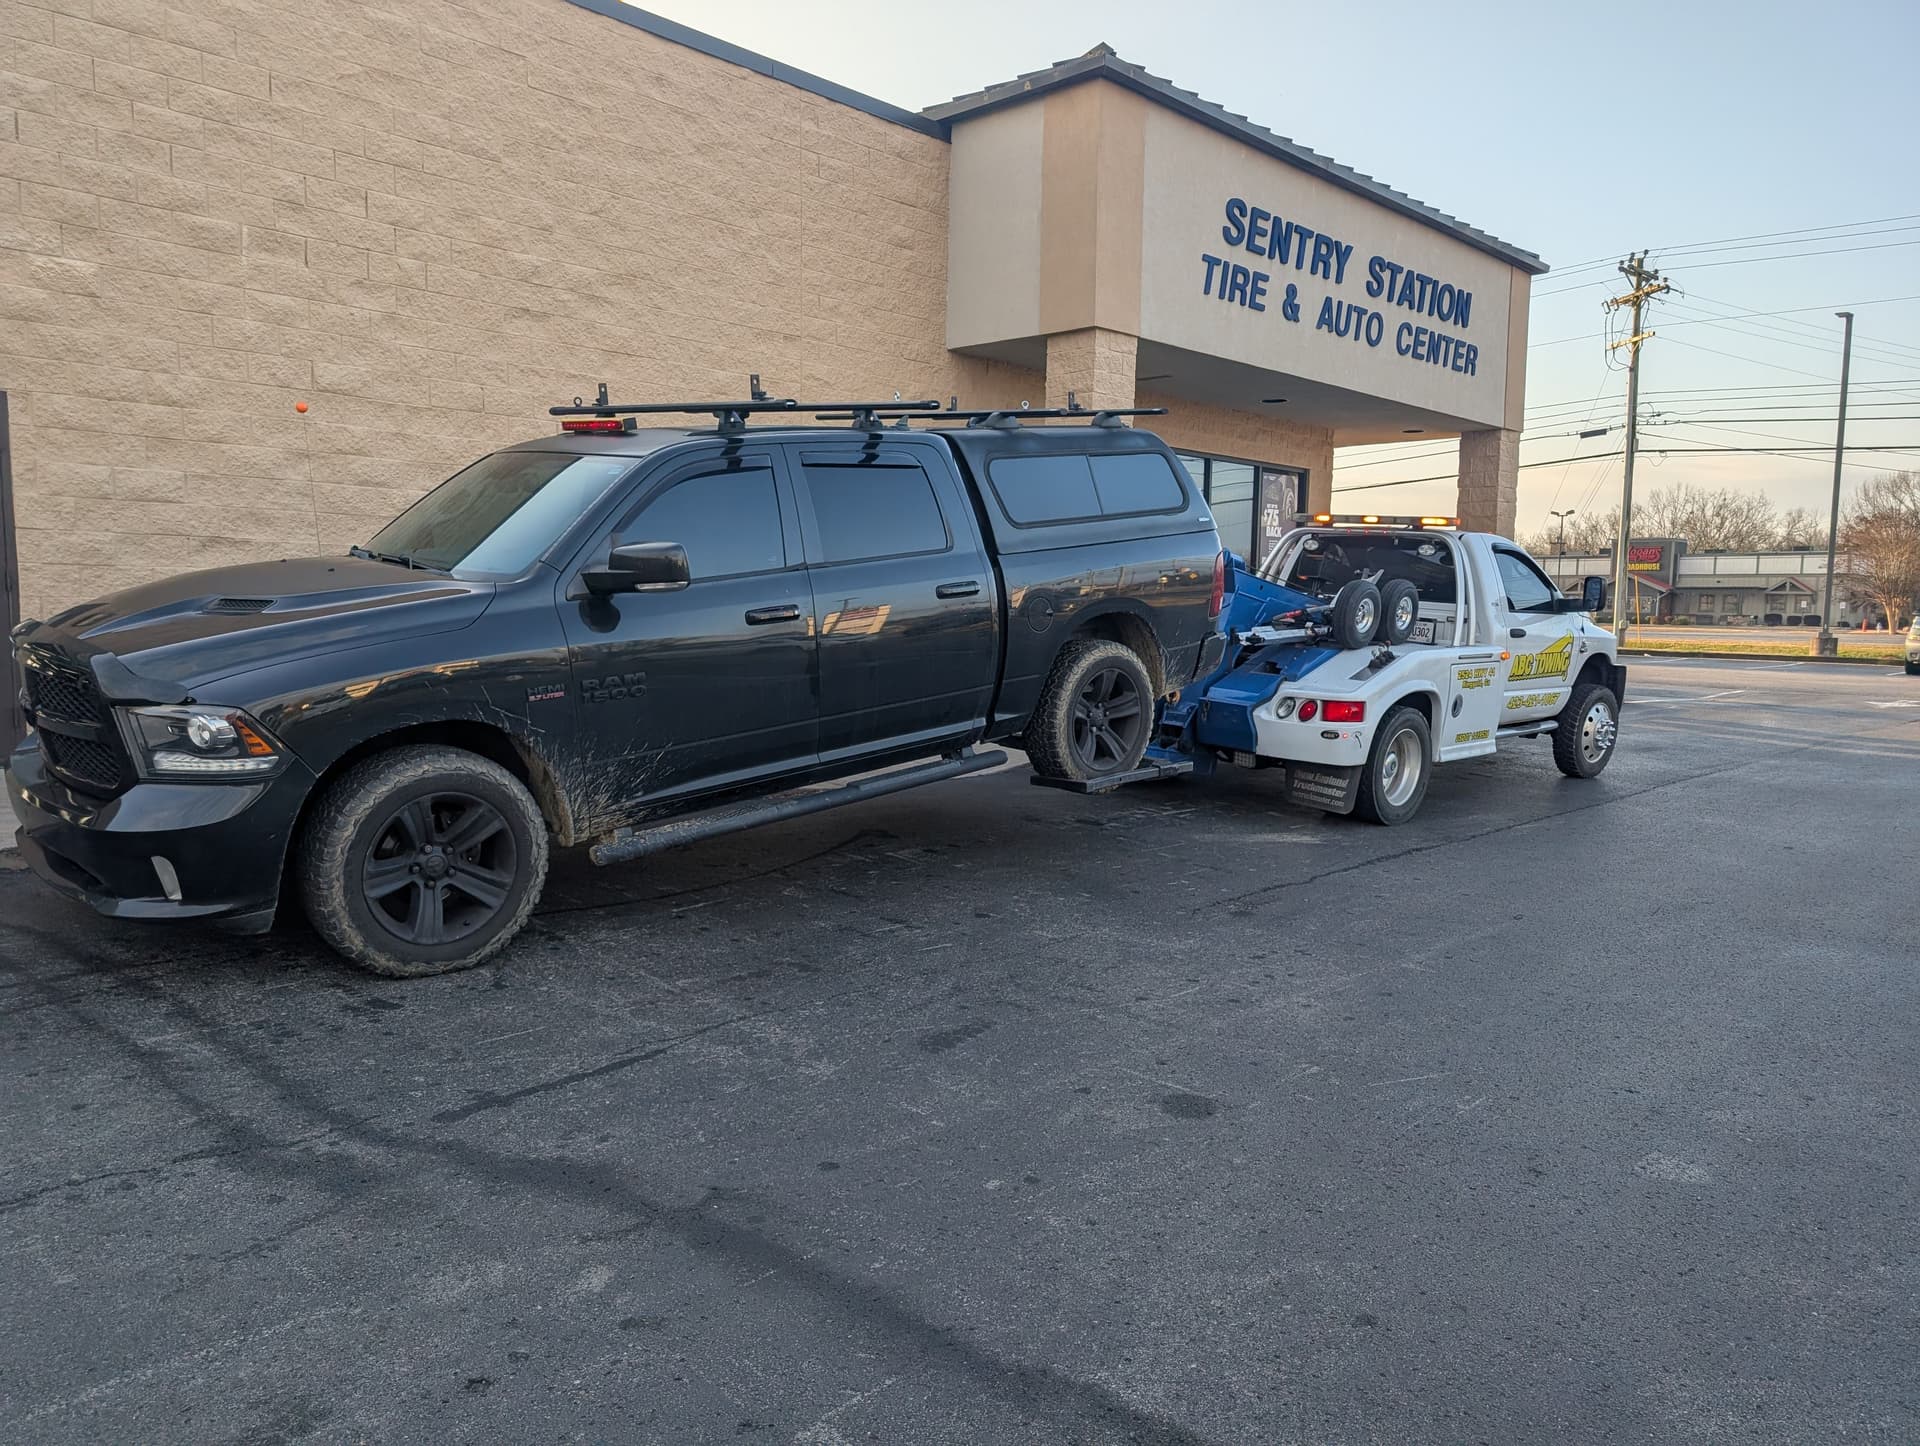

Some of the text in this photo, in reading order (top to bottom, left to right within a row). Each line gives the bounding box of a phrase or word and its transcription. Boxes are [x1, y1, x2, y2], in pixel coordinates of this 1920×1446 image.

[1222, 197, 1472, 328] SENTRY STATION
[1201, 253, 1479, 376] TIRE & AUTO CENTER
[1263, 509, 1280, 527] $75
[1266, 526, 1282, 537] BACK
[1627, 562, 1661, 571] OADHOUSE
[1411, 626, 1430, 638] J302
[1511, 652, 1570, 676] ABC TOWING
[526, 684, 565, 697] HEMI
[580, 671, 647, 691] RAM
[581, 685, 647, 705] 1500
[1293, 779, 1347, 798] Truckmaster
